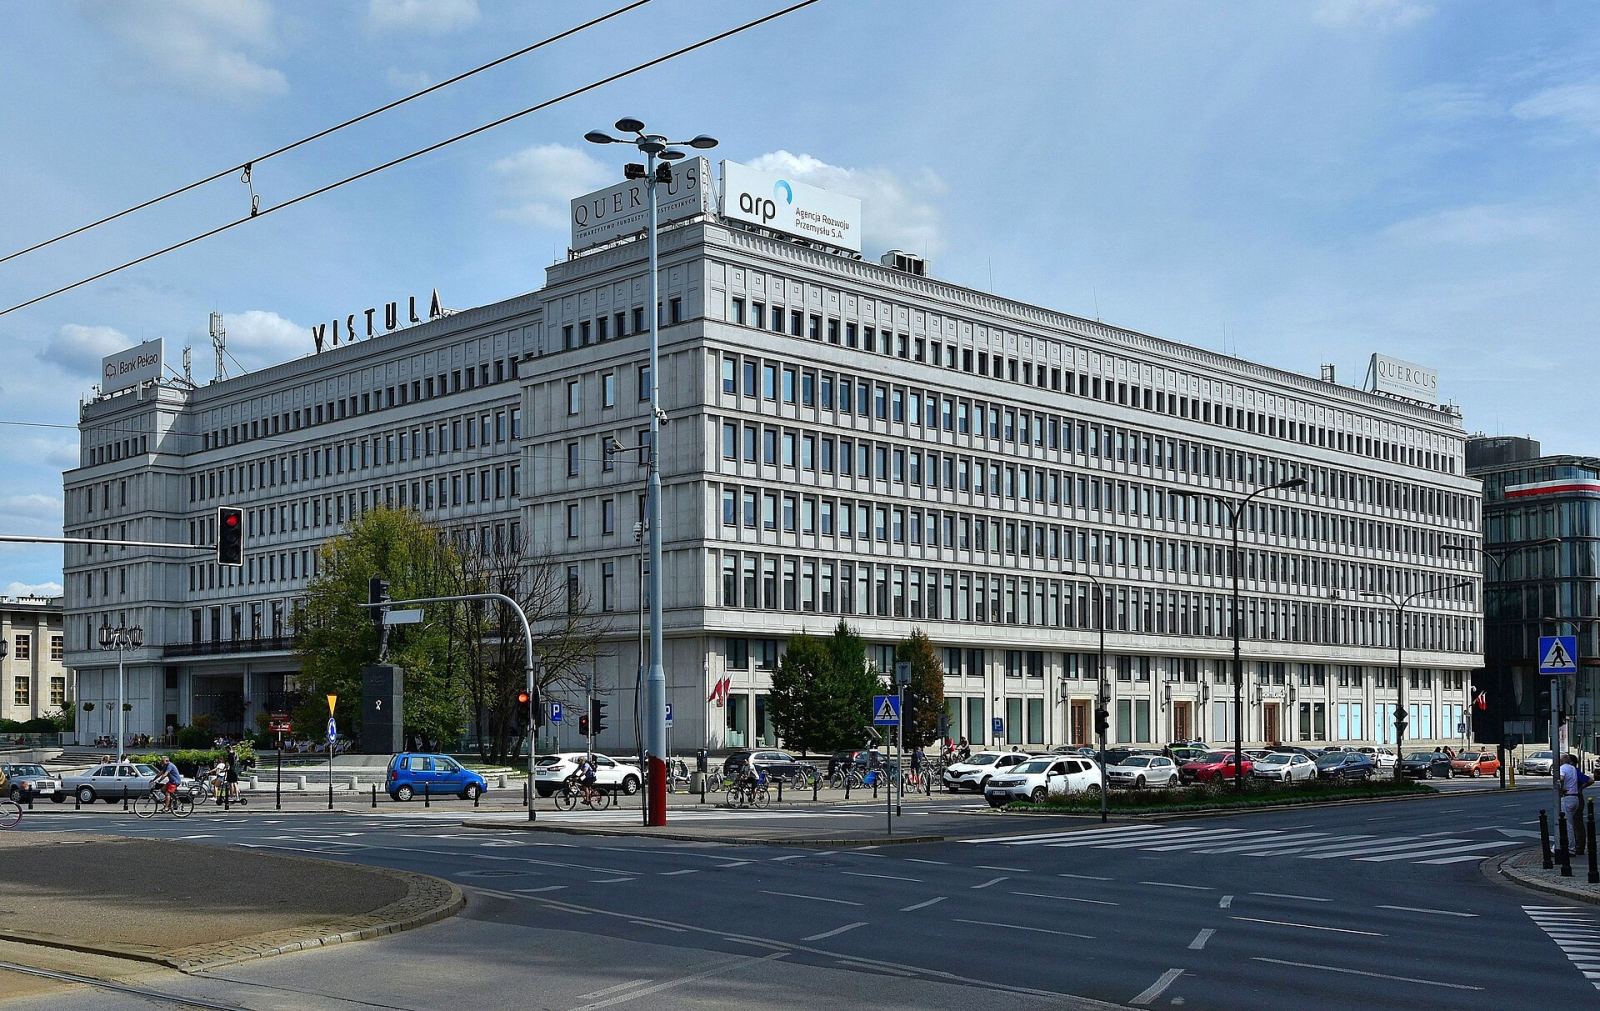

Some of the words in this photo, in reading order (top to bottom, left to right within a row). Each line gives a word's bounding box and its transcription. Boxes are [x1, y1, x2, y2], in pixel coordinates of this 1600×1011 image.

[739, 192, 776, 224] arp
[795, 207, 821, 222] Agencja
[822, 214, 850, 230] Rozwoju
[795, 218, 830, 236] Przemysłu
[831, 228, 845, 240] S.A.
[312, 288, 441, 354] VISTULA
[119, 358, 137, 375] Bank
[137, 353, 158, 369] Pekao
[1378, 360, 1436, 389] QUERCUS
[553, 704, 560, 716] P
[994, 719, 1001, 730] P
